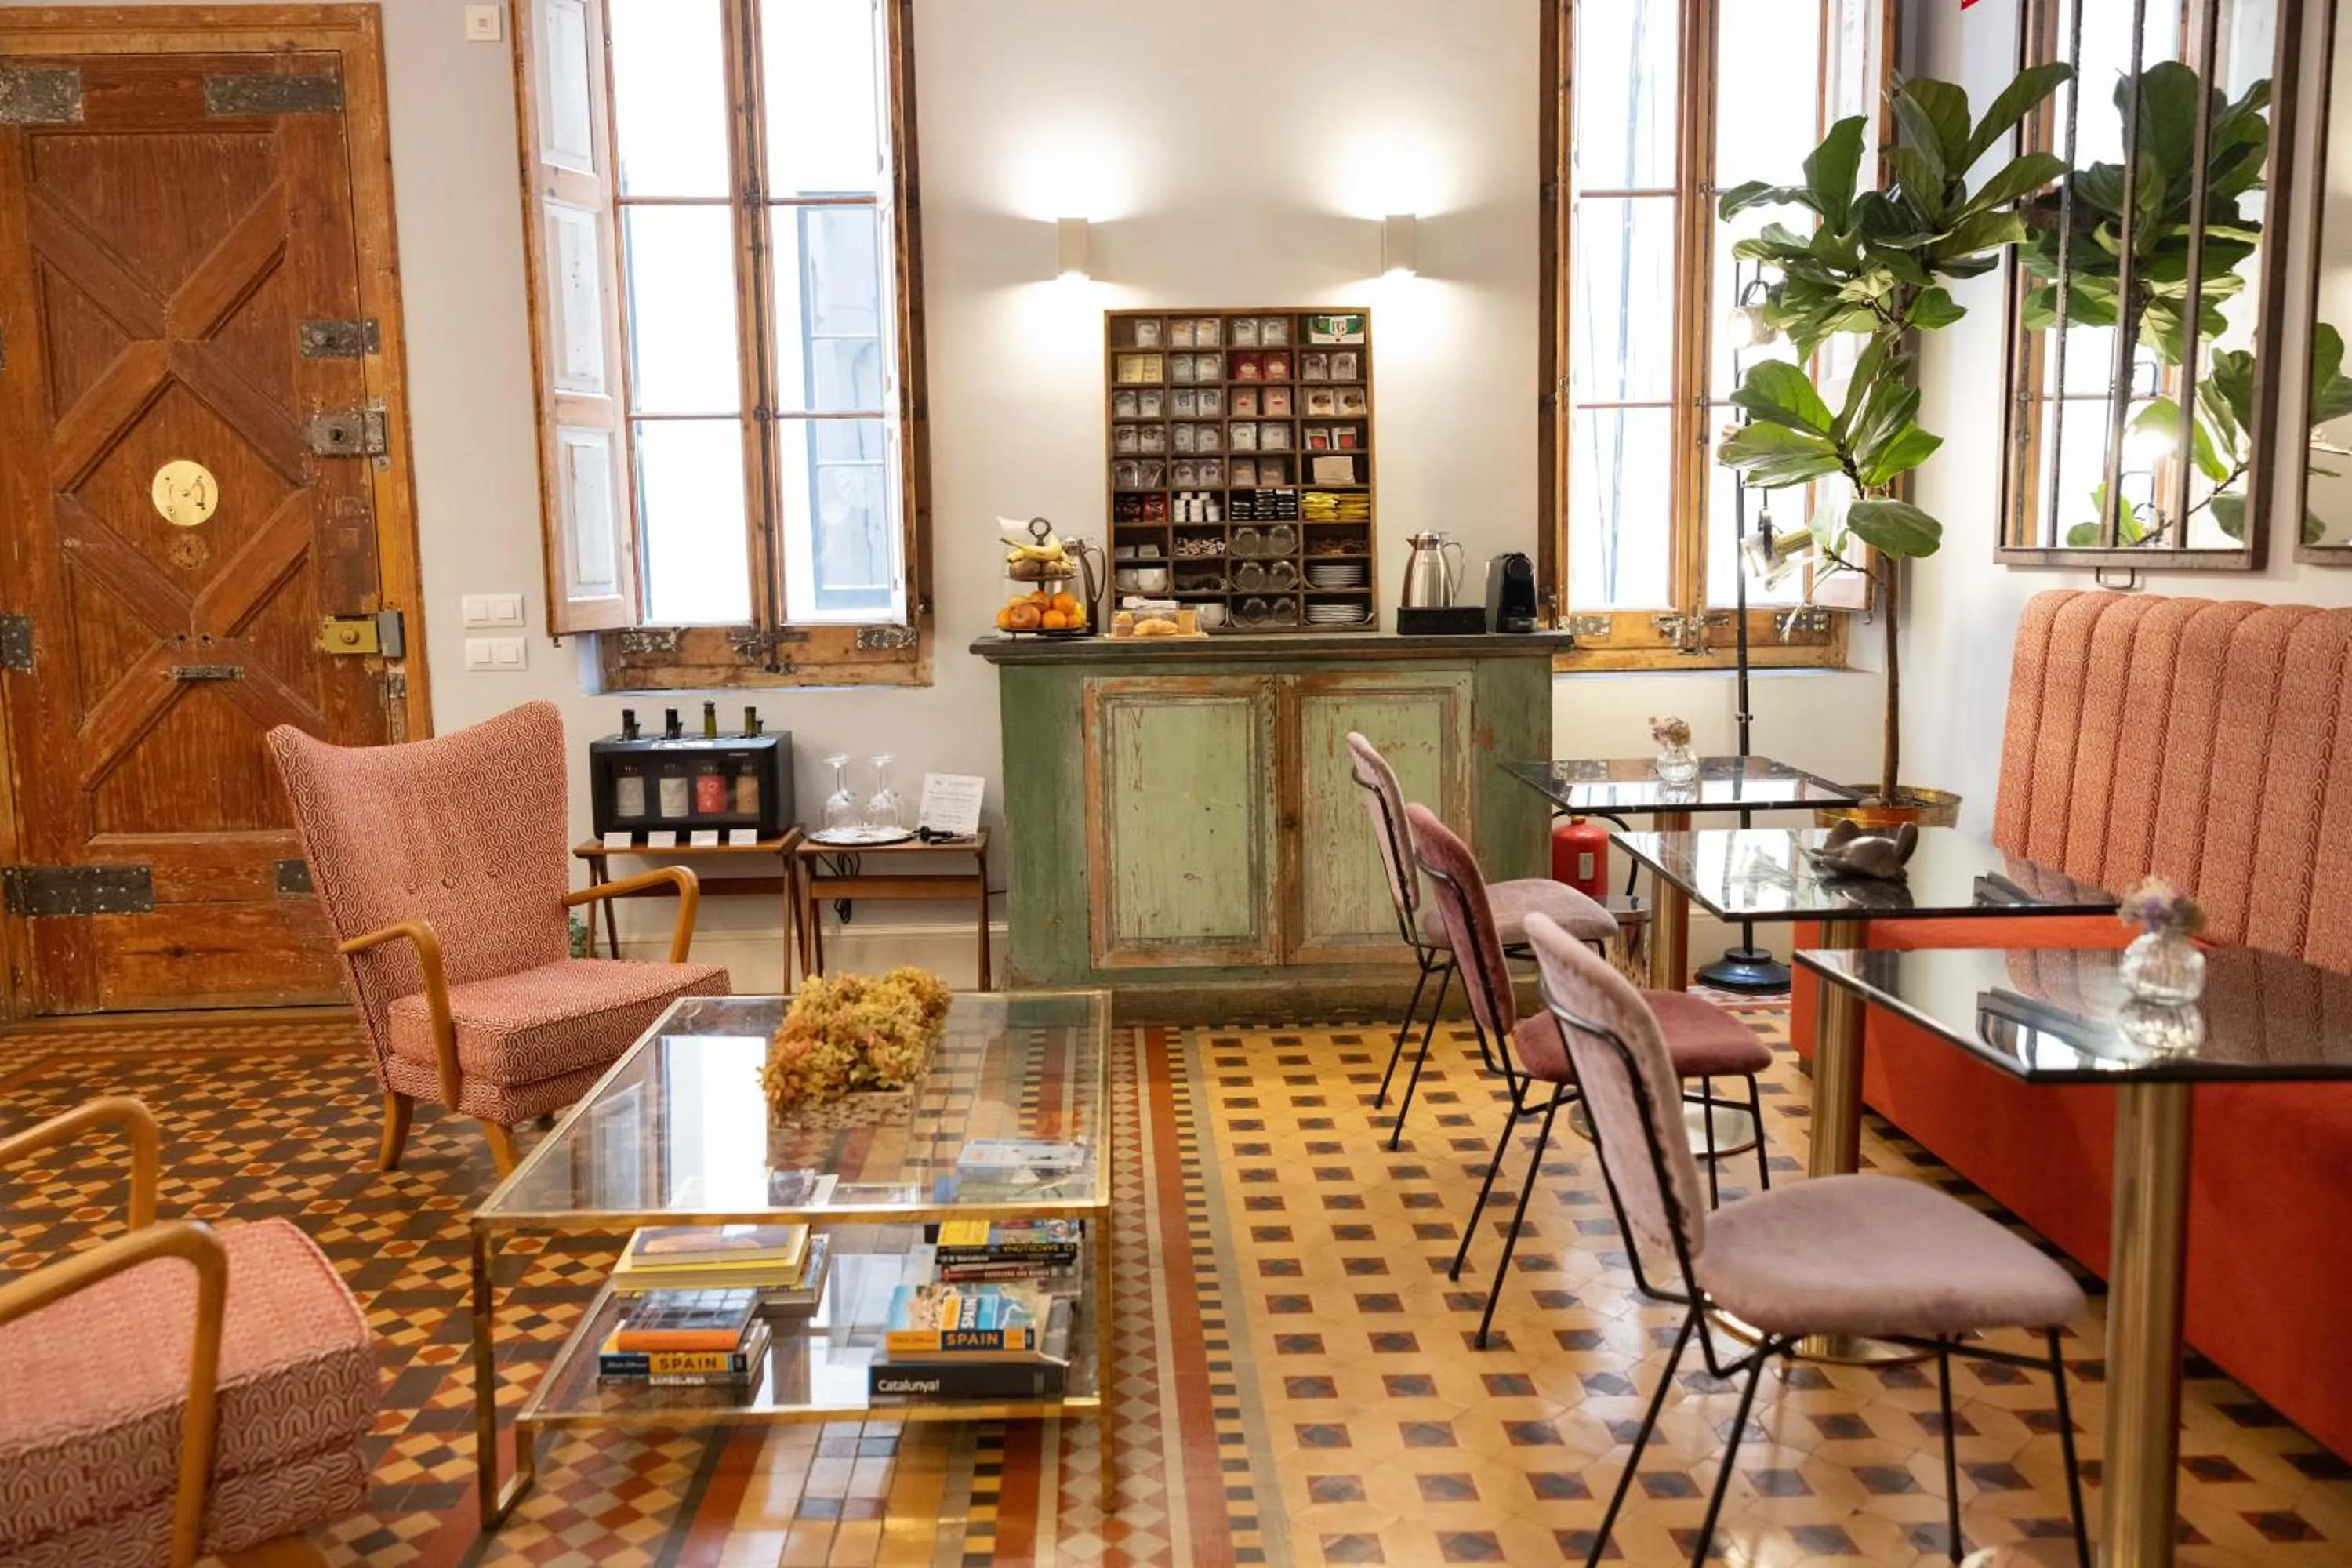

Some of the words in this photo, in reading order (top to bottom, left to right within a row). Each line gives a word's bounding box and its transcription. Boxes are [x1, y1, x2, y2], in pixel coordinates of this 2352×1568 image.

[946, 1333, 1000, 1346] SPAIN
[659, 1357, 717, 1370] SPAIN
[877, 1378, 940, 1393] Catalunya!
